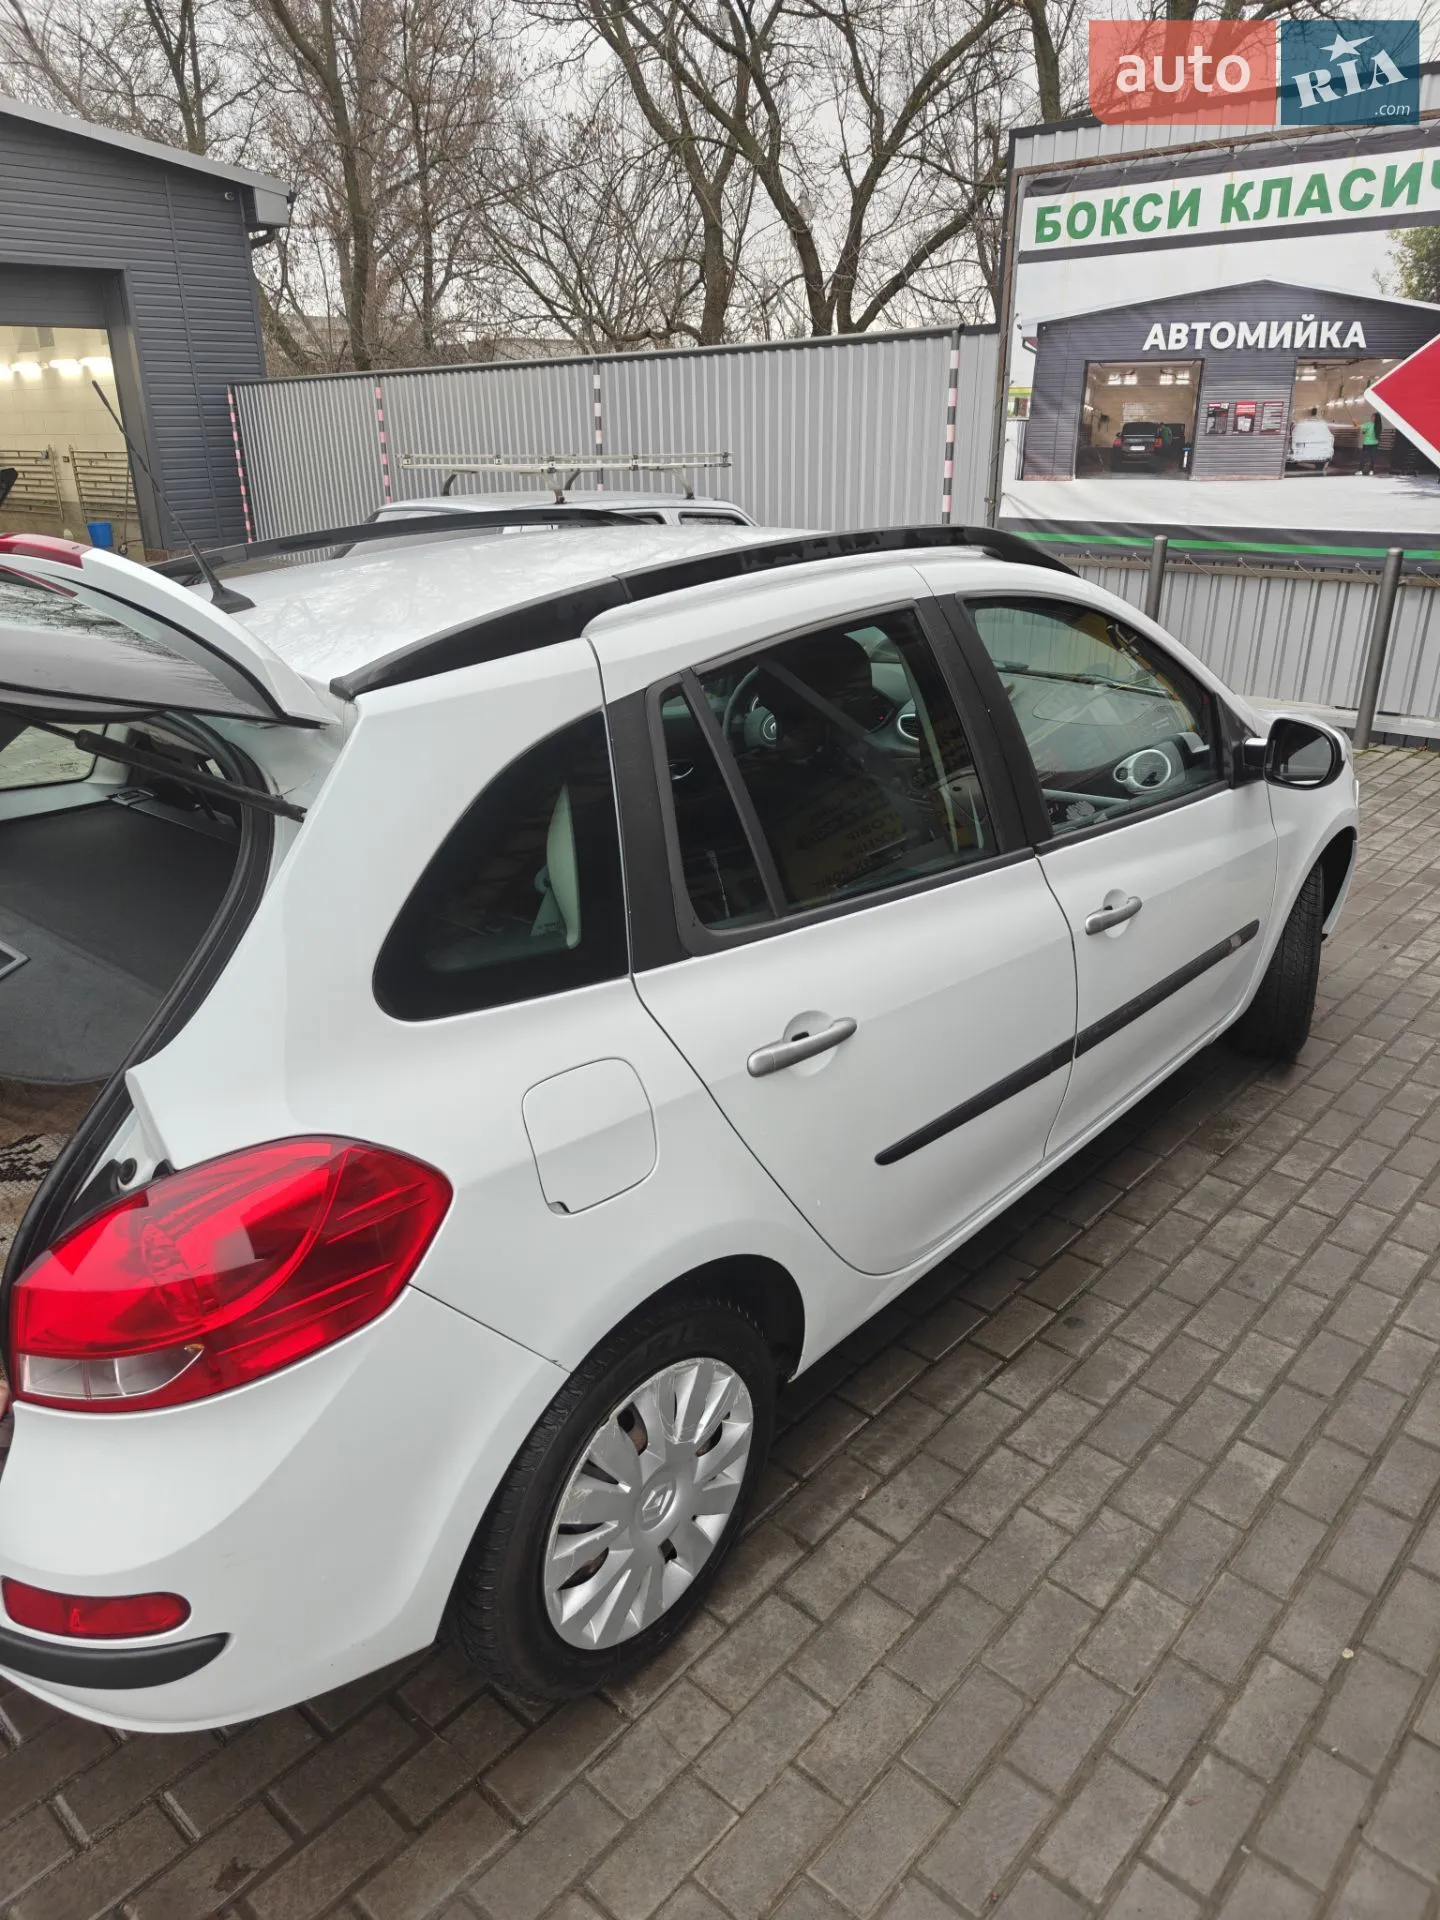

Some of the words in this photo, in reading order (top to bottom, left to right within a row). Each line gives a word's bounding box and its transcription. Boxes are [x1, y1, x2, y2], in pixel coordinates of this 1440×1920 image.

[1034, 187, 1201, 244] БОКСИ
[1219, 159, 1440, 224] КЛАСИ
[1142, 314, 1367, 351] АВТОМИЙКА
